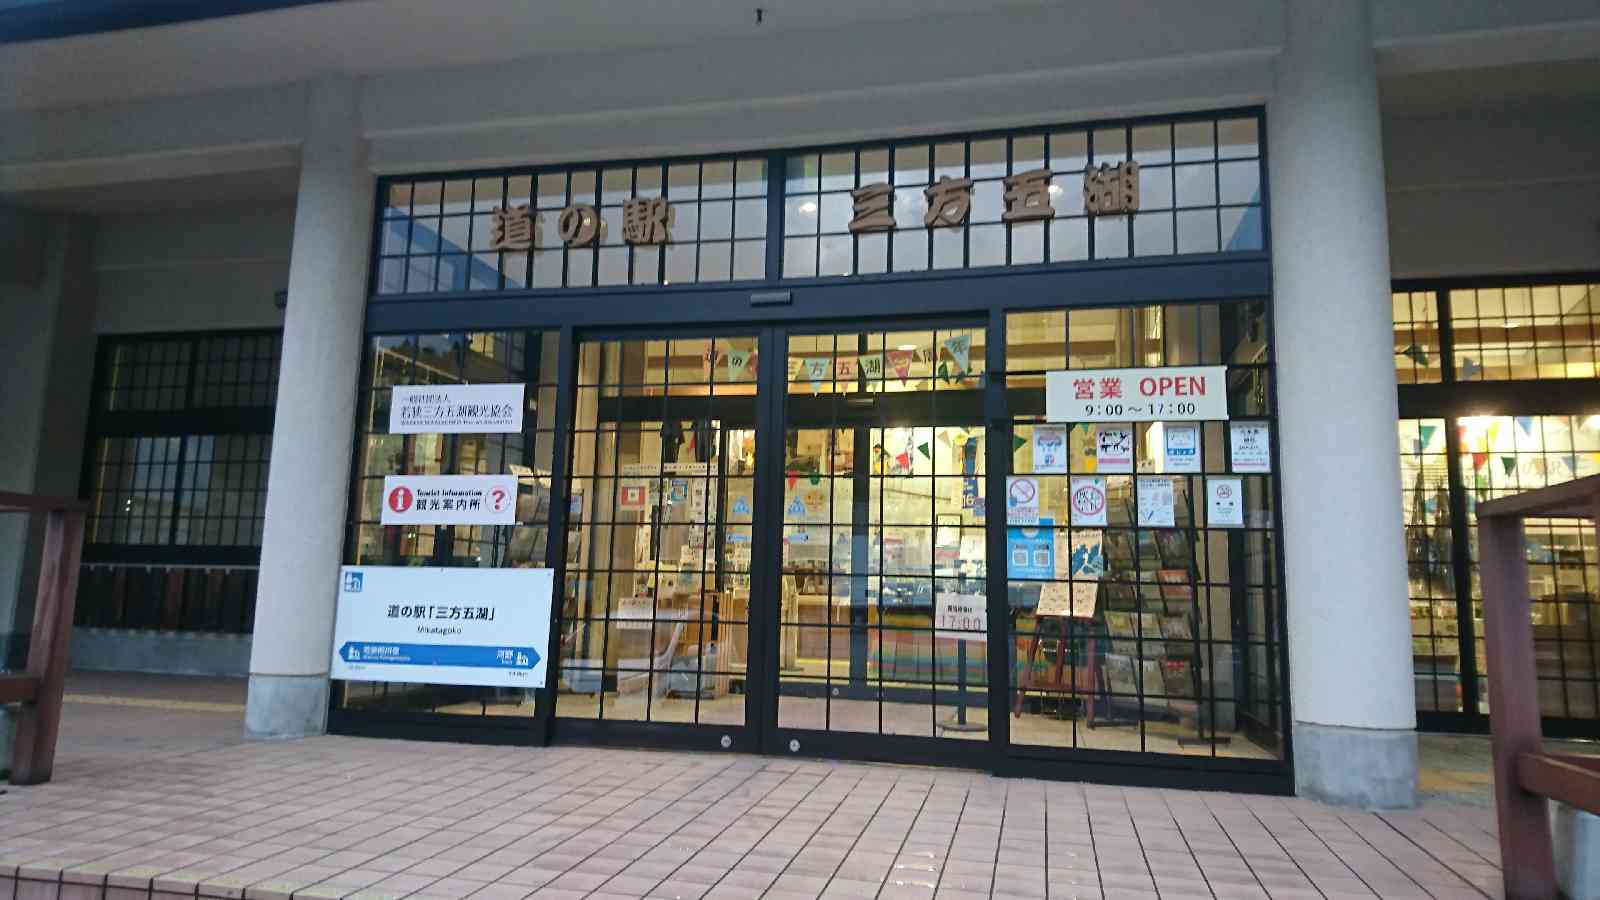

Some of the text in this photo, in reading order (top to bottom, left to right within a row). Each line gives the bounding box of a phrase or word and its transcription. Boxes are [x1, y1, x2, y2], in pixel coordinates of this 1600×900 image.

[491, 160, 1140, 252] 道の駅 三方五湖
[1073, 376, 1206, 400] 営業 OPEN
[443, 488, 482, 497] Information
[416, 499, 480, 511] 観光案内所
[388, 604, 495, 621] 道の駅「三方五湖」
